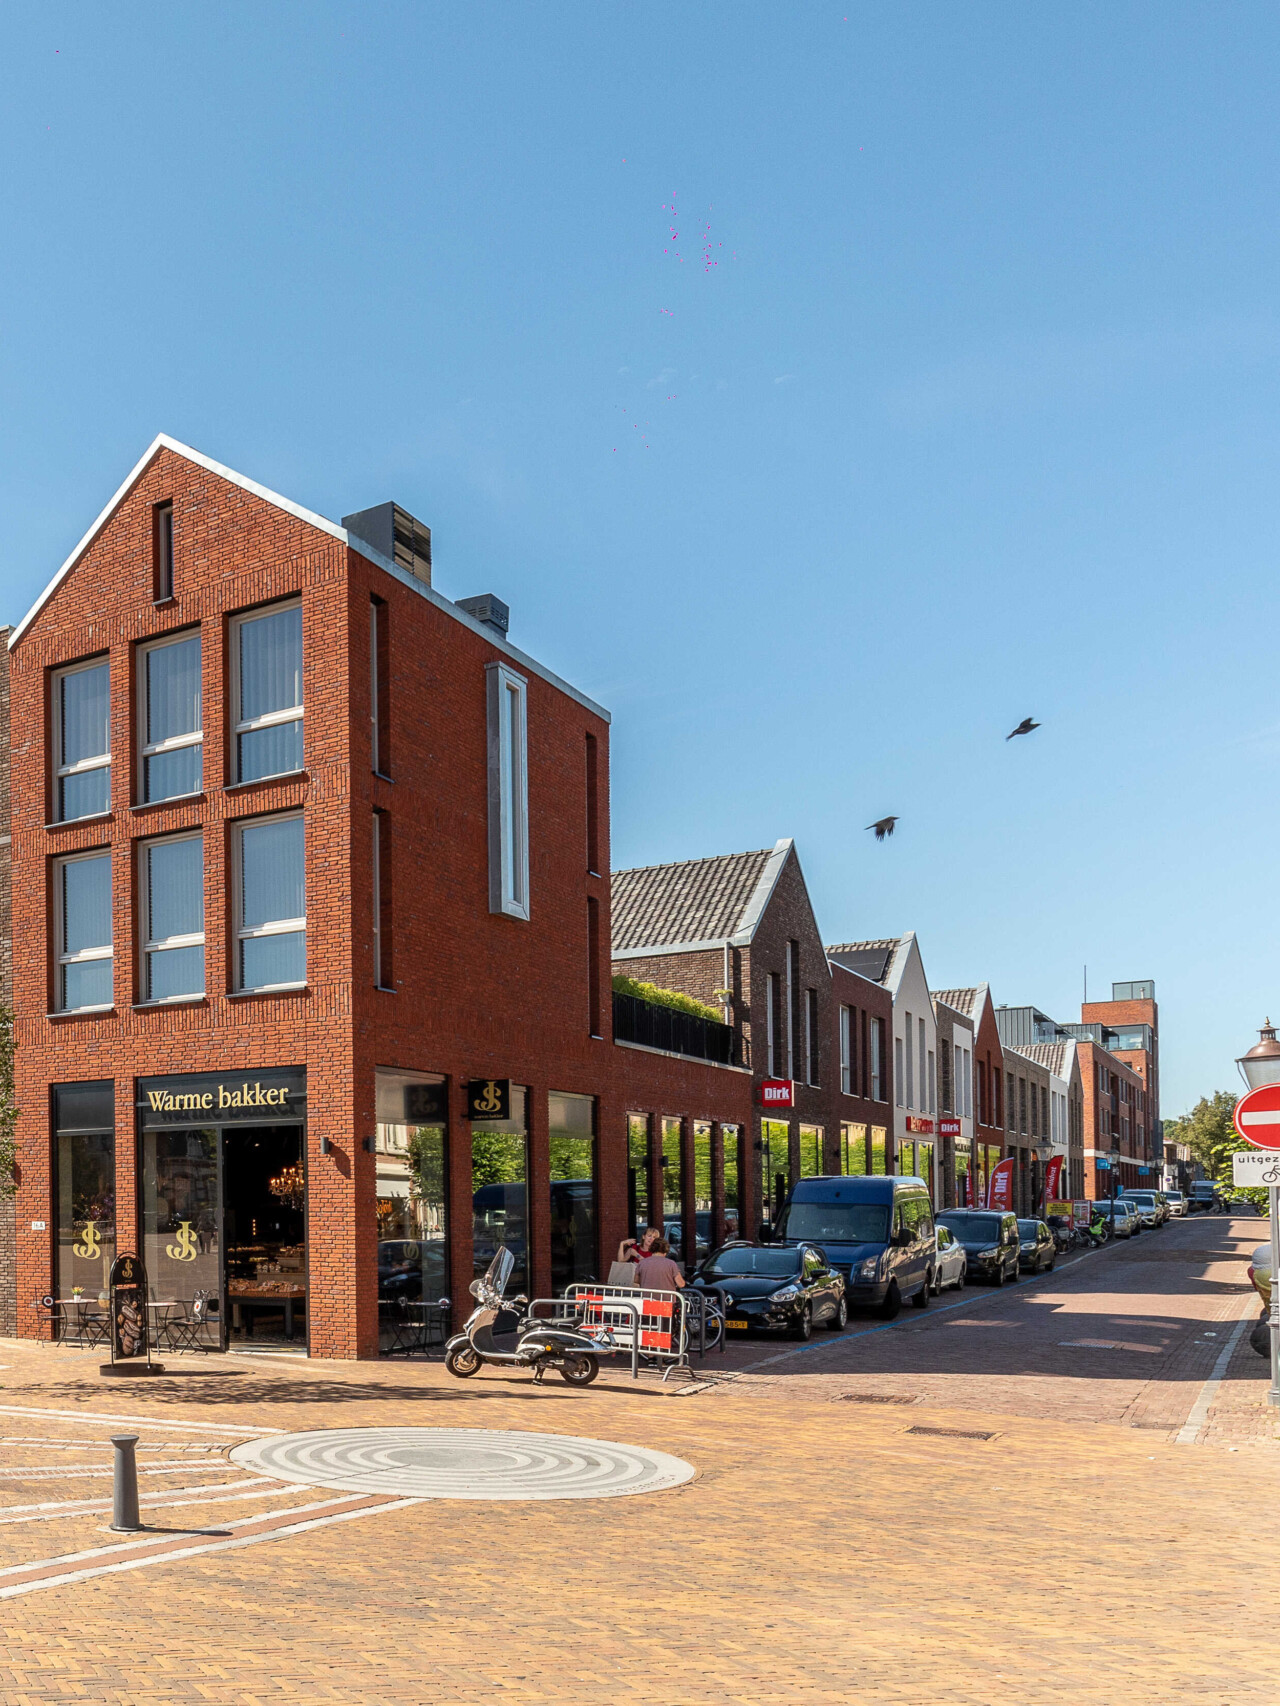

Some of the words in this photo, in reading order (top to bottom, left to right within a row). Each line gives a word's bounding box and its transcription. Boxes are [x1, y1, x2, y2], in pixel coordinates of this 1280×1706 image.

[147, 1090, 213, 1112] Warme
[218, 1082, 289, 1109] bakker
[764, 1087, 790, 1100] Dirk
[941, 1124, 959, 1132] Dirk
[994, 1172, 1009, 1193] Dirk
